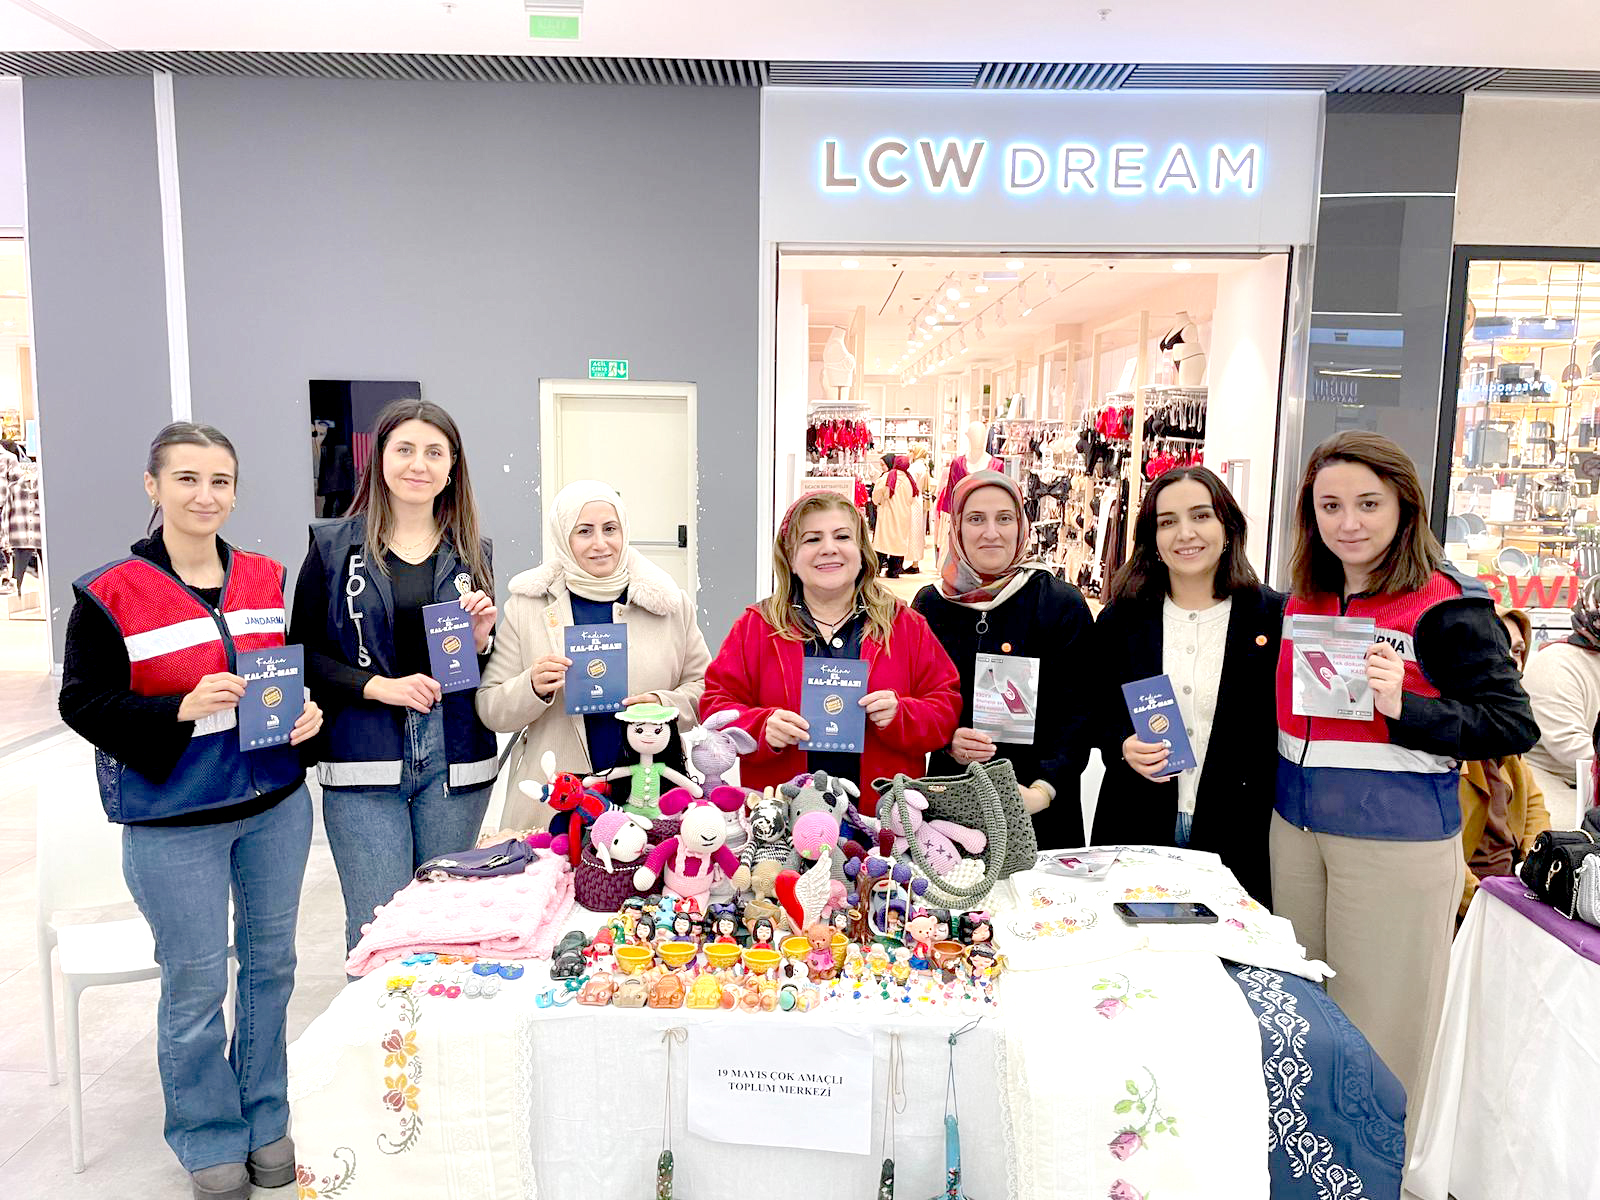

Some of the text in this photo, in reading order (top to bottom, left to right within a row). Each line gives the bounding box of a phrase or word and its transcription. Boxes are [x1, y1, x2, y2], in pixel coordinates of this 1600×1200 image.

[825, 141, 1255, 189] LCW DREAM
[1374, 634, 1405, 654] RMA
[718, 1069, 843, 1085] 19 MAYIS ÇOK AMAÇLI
[728, 1082, 832, 1097] TOPLUM MERKEZİ
